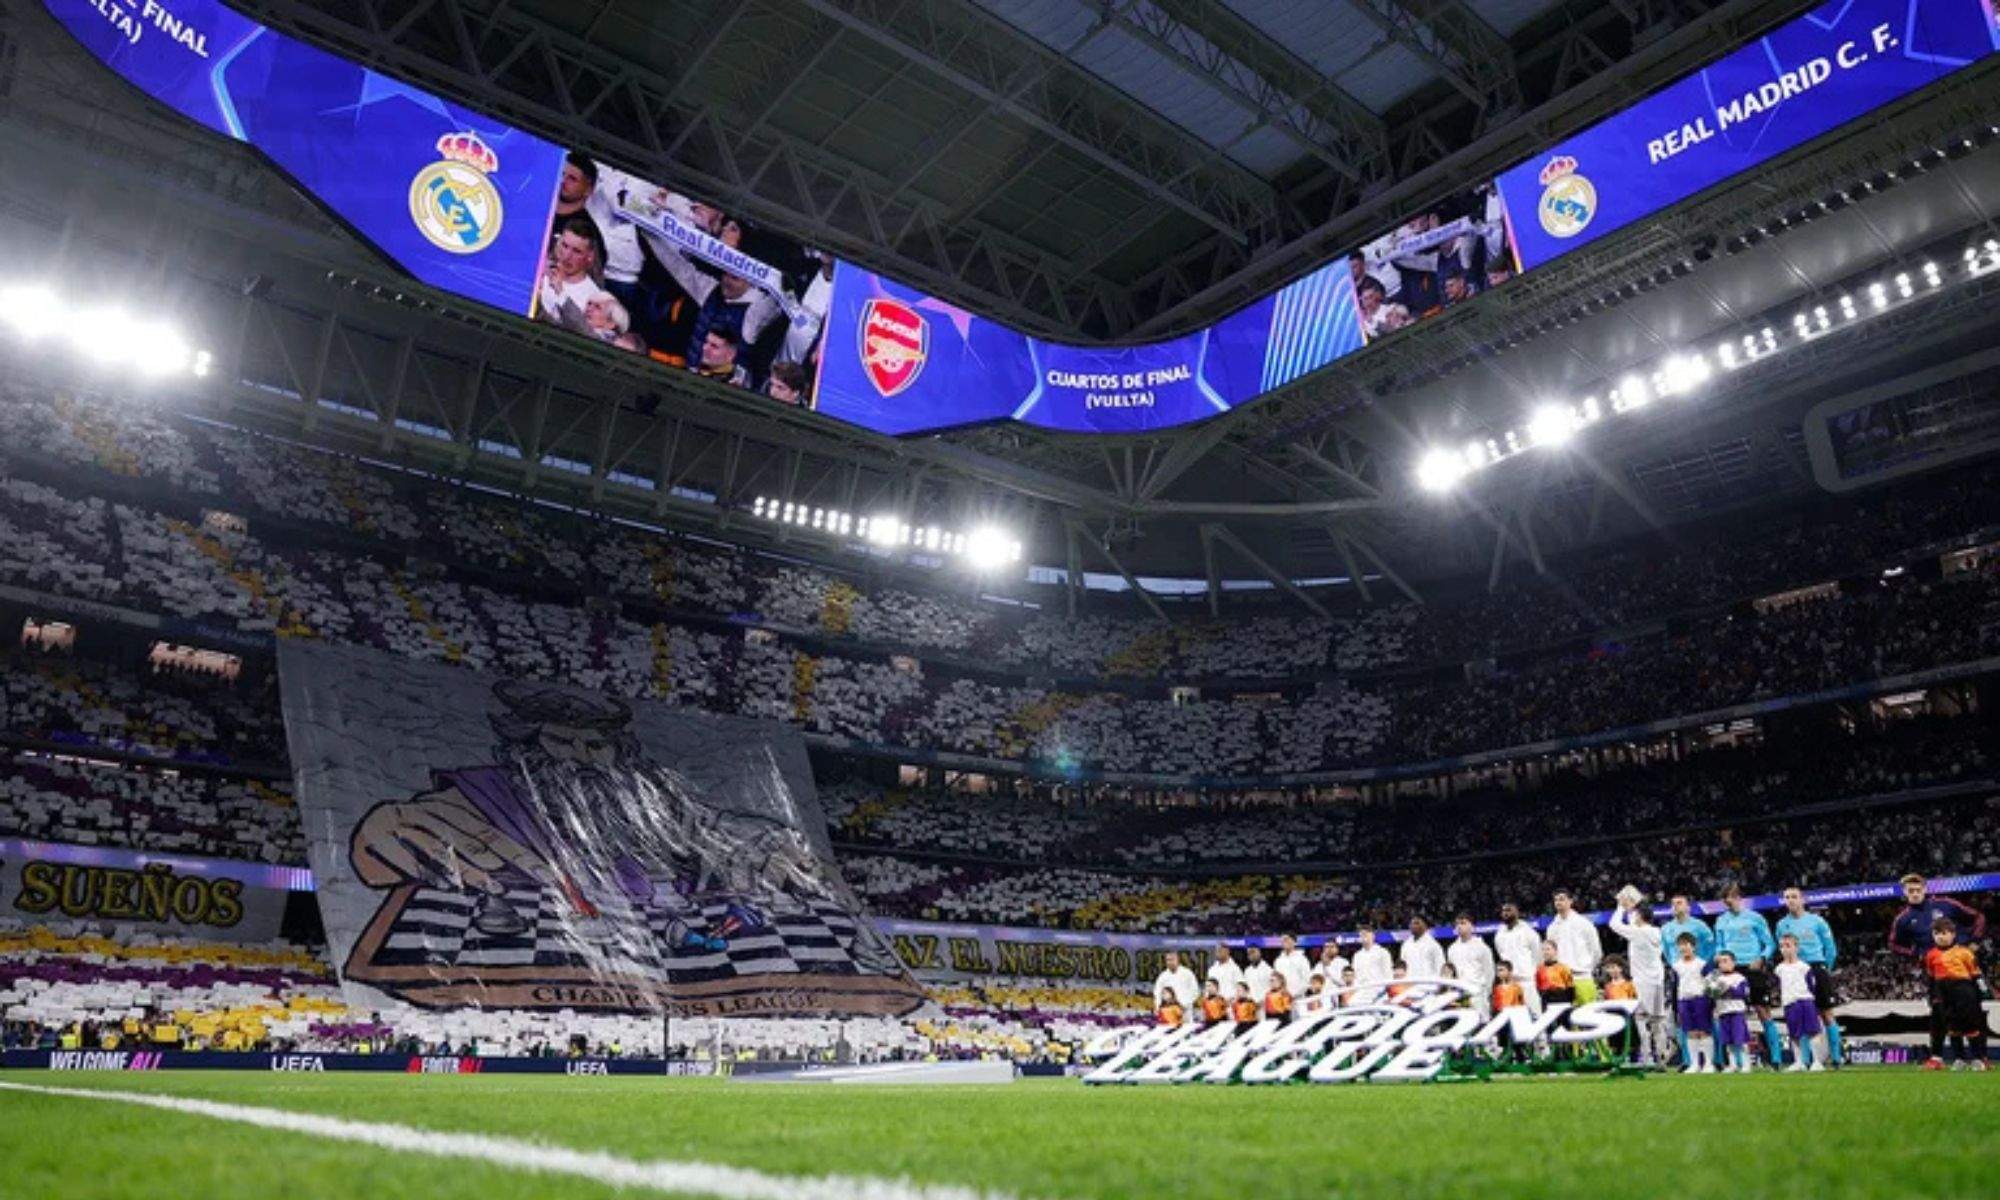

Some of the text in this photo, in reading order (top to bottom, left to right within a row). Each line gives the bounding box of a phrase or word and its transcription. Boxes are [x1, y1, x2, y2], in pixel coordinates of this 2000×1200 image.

[90, 0, 142, 44] LTA)
[142, 0, 209, 58] FINAL
[1648, 22, 1899, 165] REAL MADRID C. F.
[662, 215, 770, 279] Real Madrid
[1046, 364, 1191, 389] CUARTOS DE FINAL
[1085, 391, 1155, 409] (VUELTA)
[13, 858, 244, 927] SUEÑOS
[947, 937, 993, 974] EL
[994, 940, 1132, 983] NUESTRO
[1083, 1000, 1640, 1057] CHAMPIONS
[272, 1055, 324, 1071] UEFA
[566, 1061, 608, 1075] UEFA
[1083, 1041, 1446, 1085] LEAGUE
